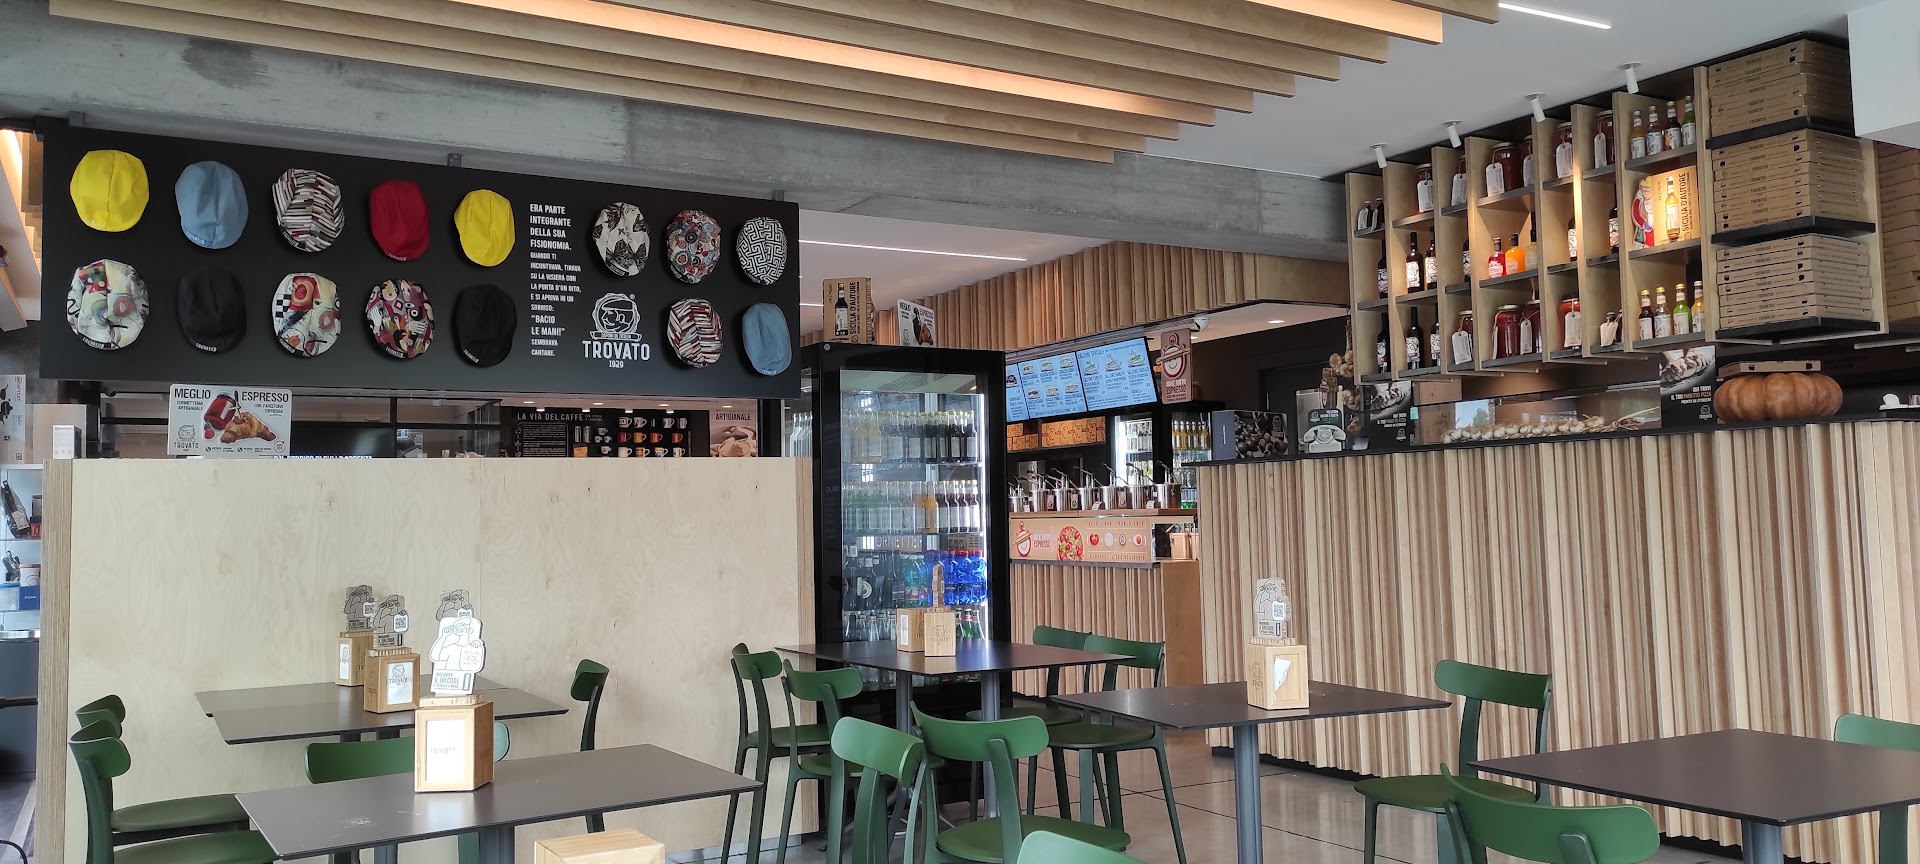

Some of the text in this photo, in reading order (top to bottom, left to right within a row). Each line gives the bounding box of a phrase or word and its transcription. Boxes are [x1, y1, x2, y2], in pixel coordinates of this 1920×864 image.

[530, 204, 565, 214] ERA PARTE
[530, 215, 571, 227] INTEGRANTE
[1681, 207, 1689, 231] SICILIA
[530, 227, 566, 238] DELLA SUA
[530, 239, 572, 251] FISIONOMIA,
[531, 327, 540, 335] LE
[582, 340, 650, 360] TROVATO
[174, 388, 211, 399] MEGLIO
[242, 391, 289, 403] ESPRESSO
